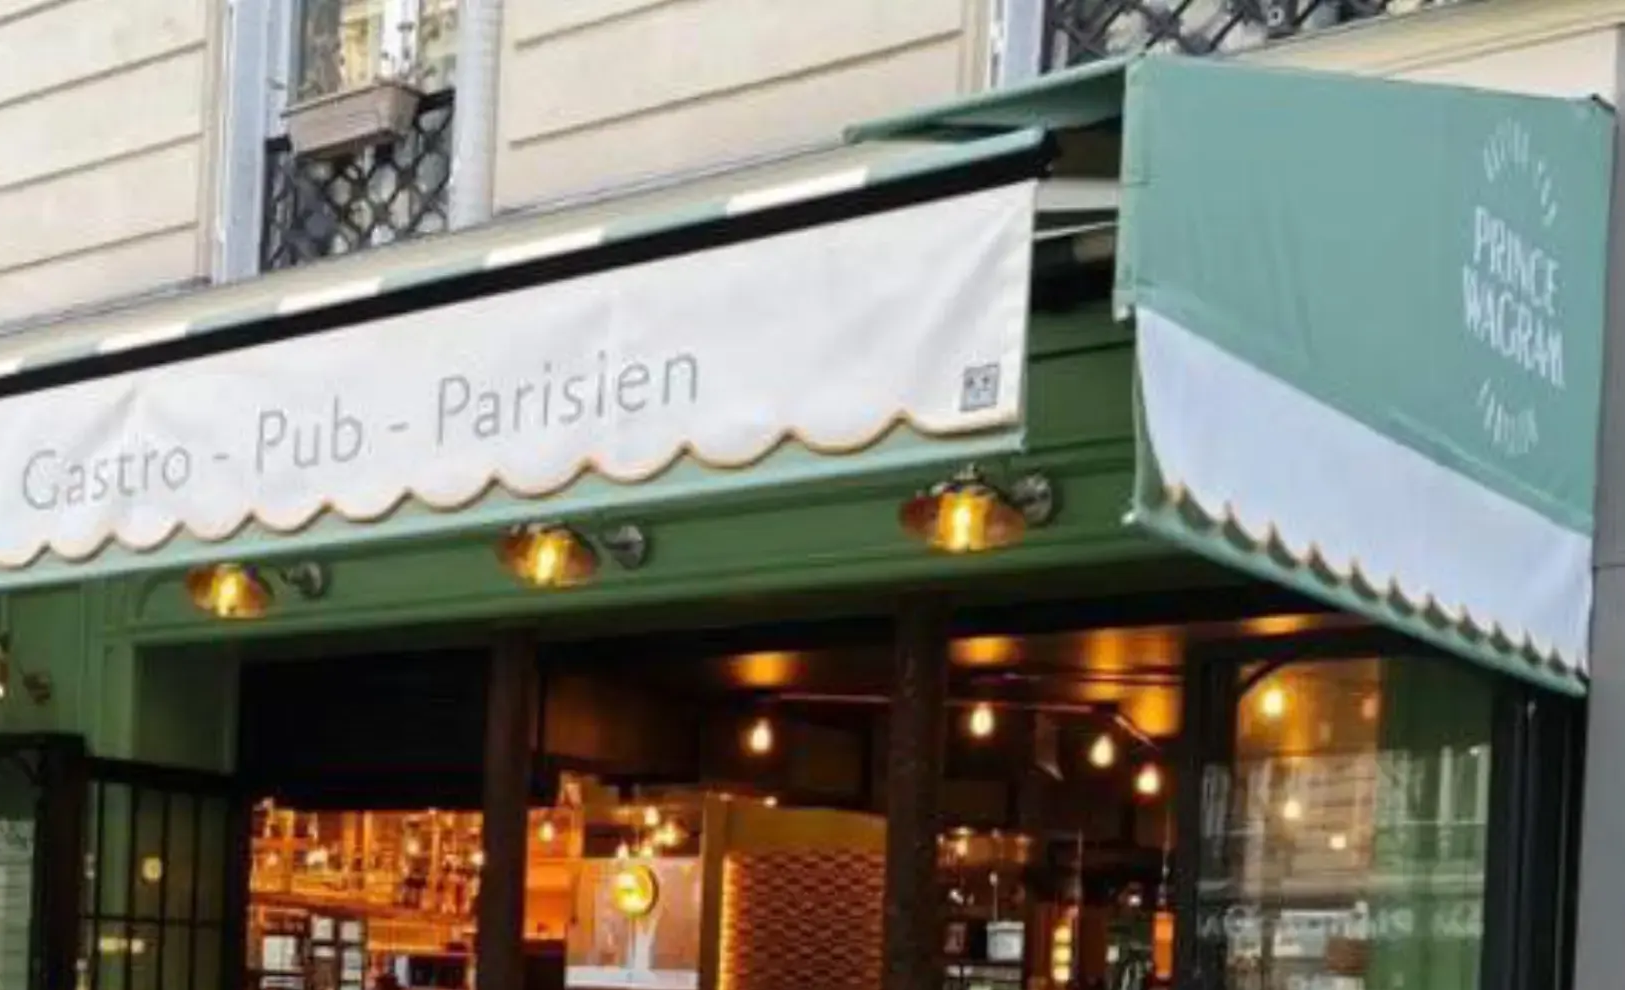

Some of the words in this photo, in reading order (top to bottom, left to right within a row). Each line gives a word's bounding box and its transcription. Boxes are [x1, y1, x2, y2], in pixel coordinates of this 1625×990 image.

[1474, 204, 1559, 317] PRINCE
[1463, 264, 1565, 390] WAGRAM
[23, 445, 192, 510] Gastro
[255, 394, 363, 473] Pub
[436, 349, 698, 447] Parisien
